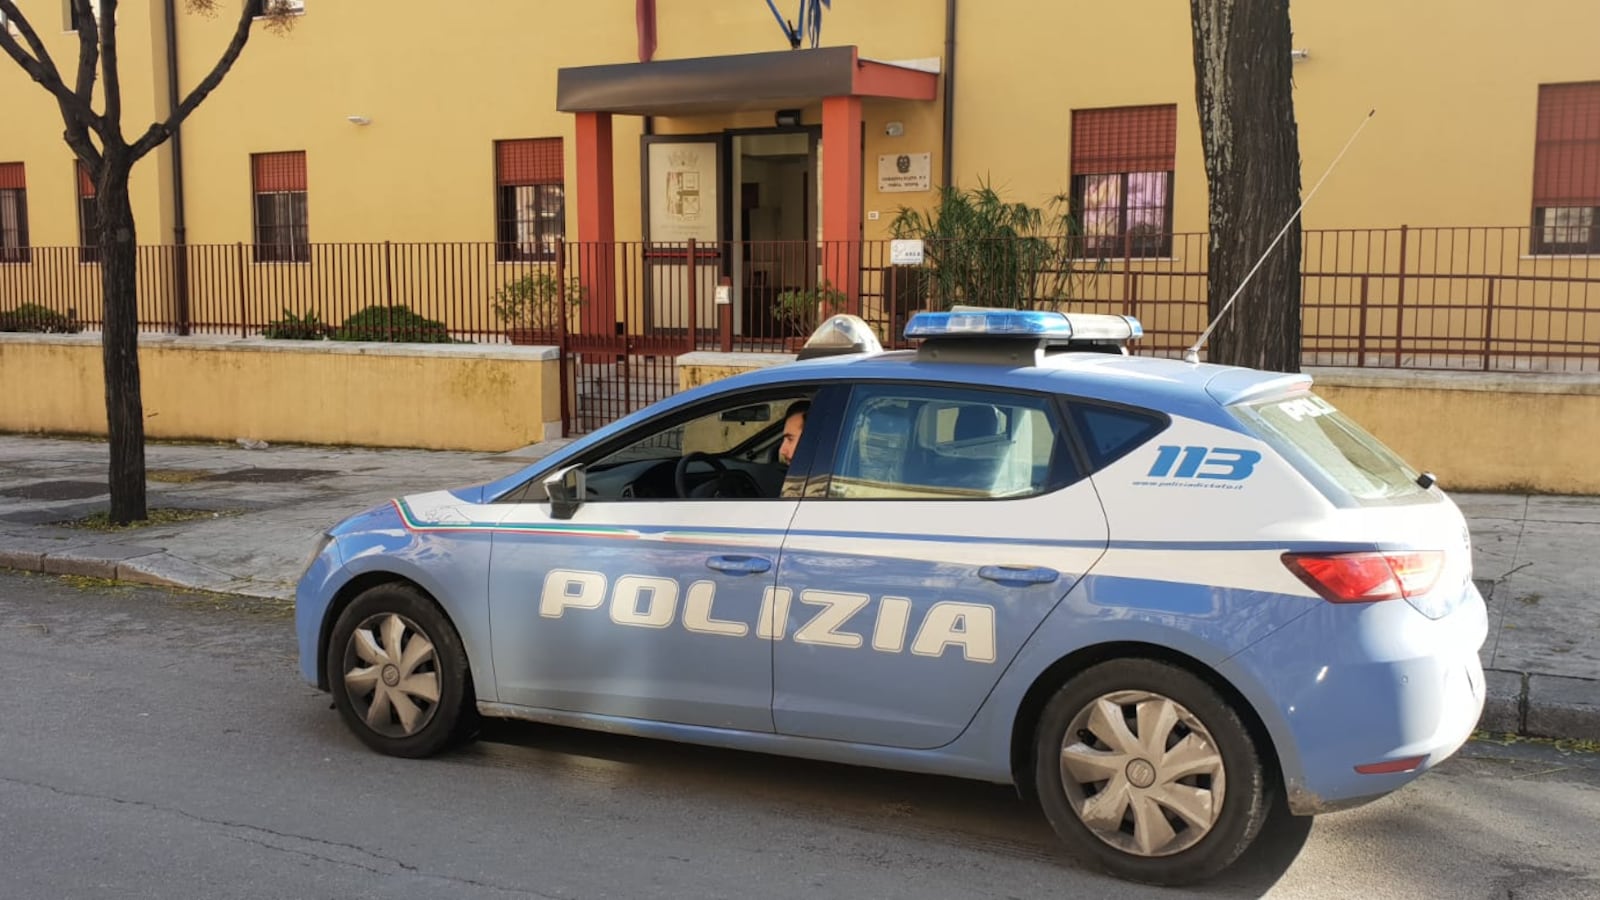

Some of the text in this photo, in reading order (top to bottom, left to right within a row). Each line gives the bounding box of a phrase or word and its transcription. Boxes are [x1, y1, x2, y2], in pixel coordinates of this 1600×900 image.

[1147, 445, 1262, 481] 113
[1132, 480, 1244, 490] www.poliziadistato.it
[539, 568, 996, 663] POLIZIA
